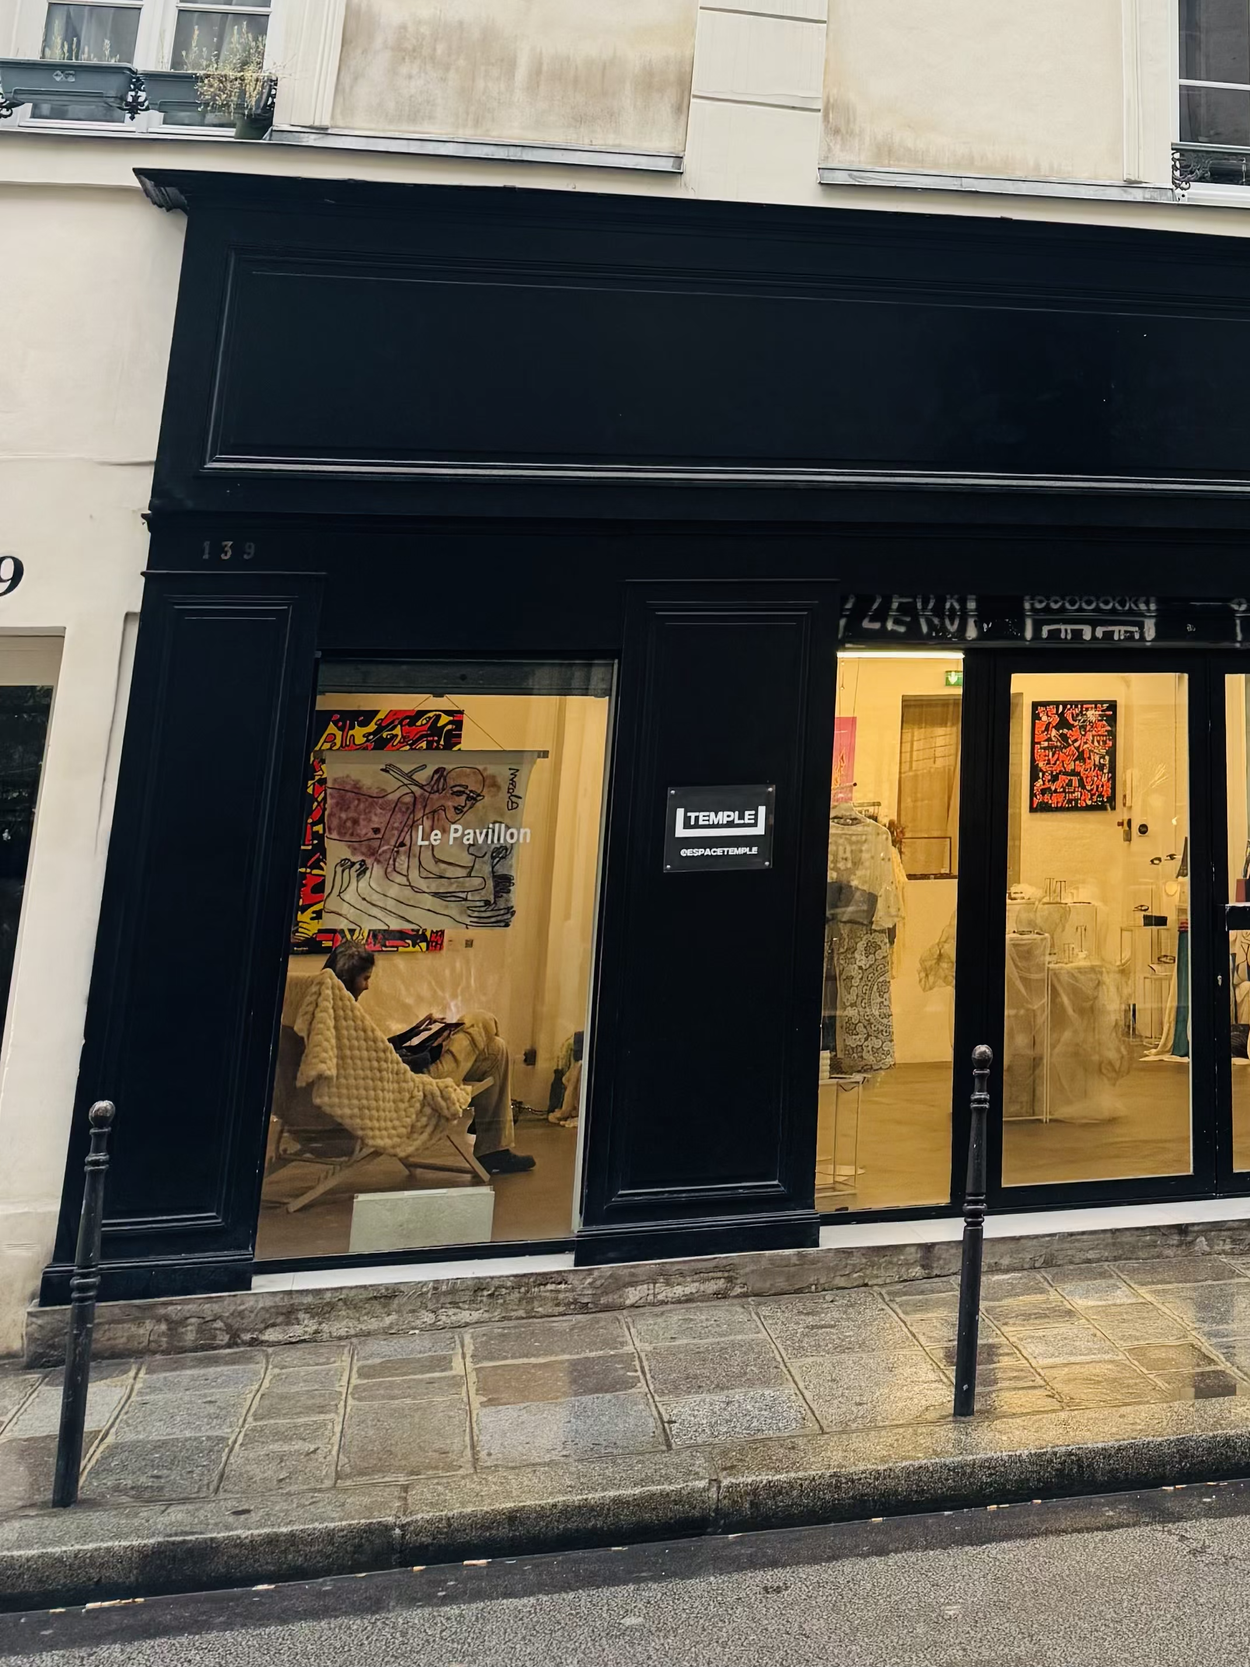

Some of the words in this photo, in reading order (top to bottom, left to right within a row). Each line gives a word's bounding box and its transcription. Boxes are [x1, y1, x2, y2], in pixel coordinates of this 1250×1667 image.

[201, 540, 256, 561] 139
[686, 810, 756, 826] TEMPLE
[416, 825, 443, 846] Le
[448, 822, 532, 846] Pavillon
[679, 846, 759, 857] @ESPACETEMPLE
